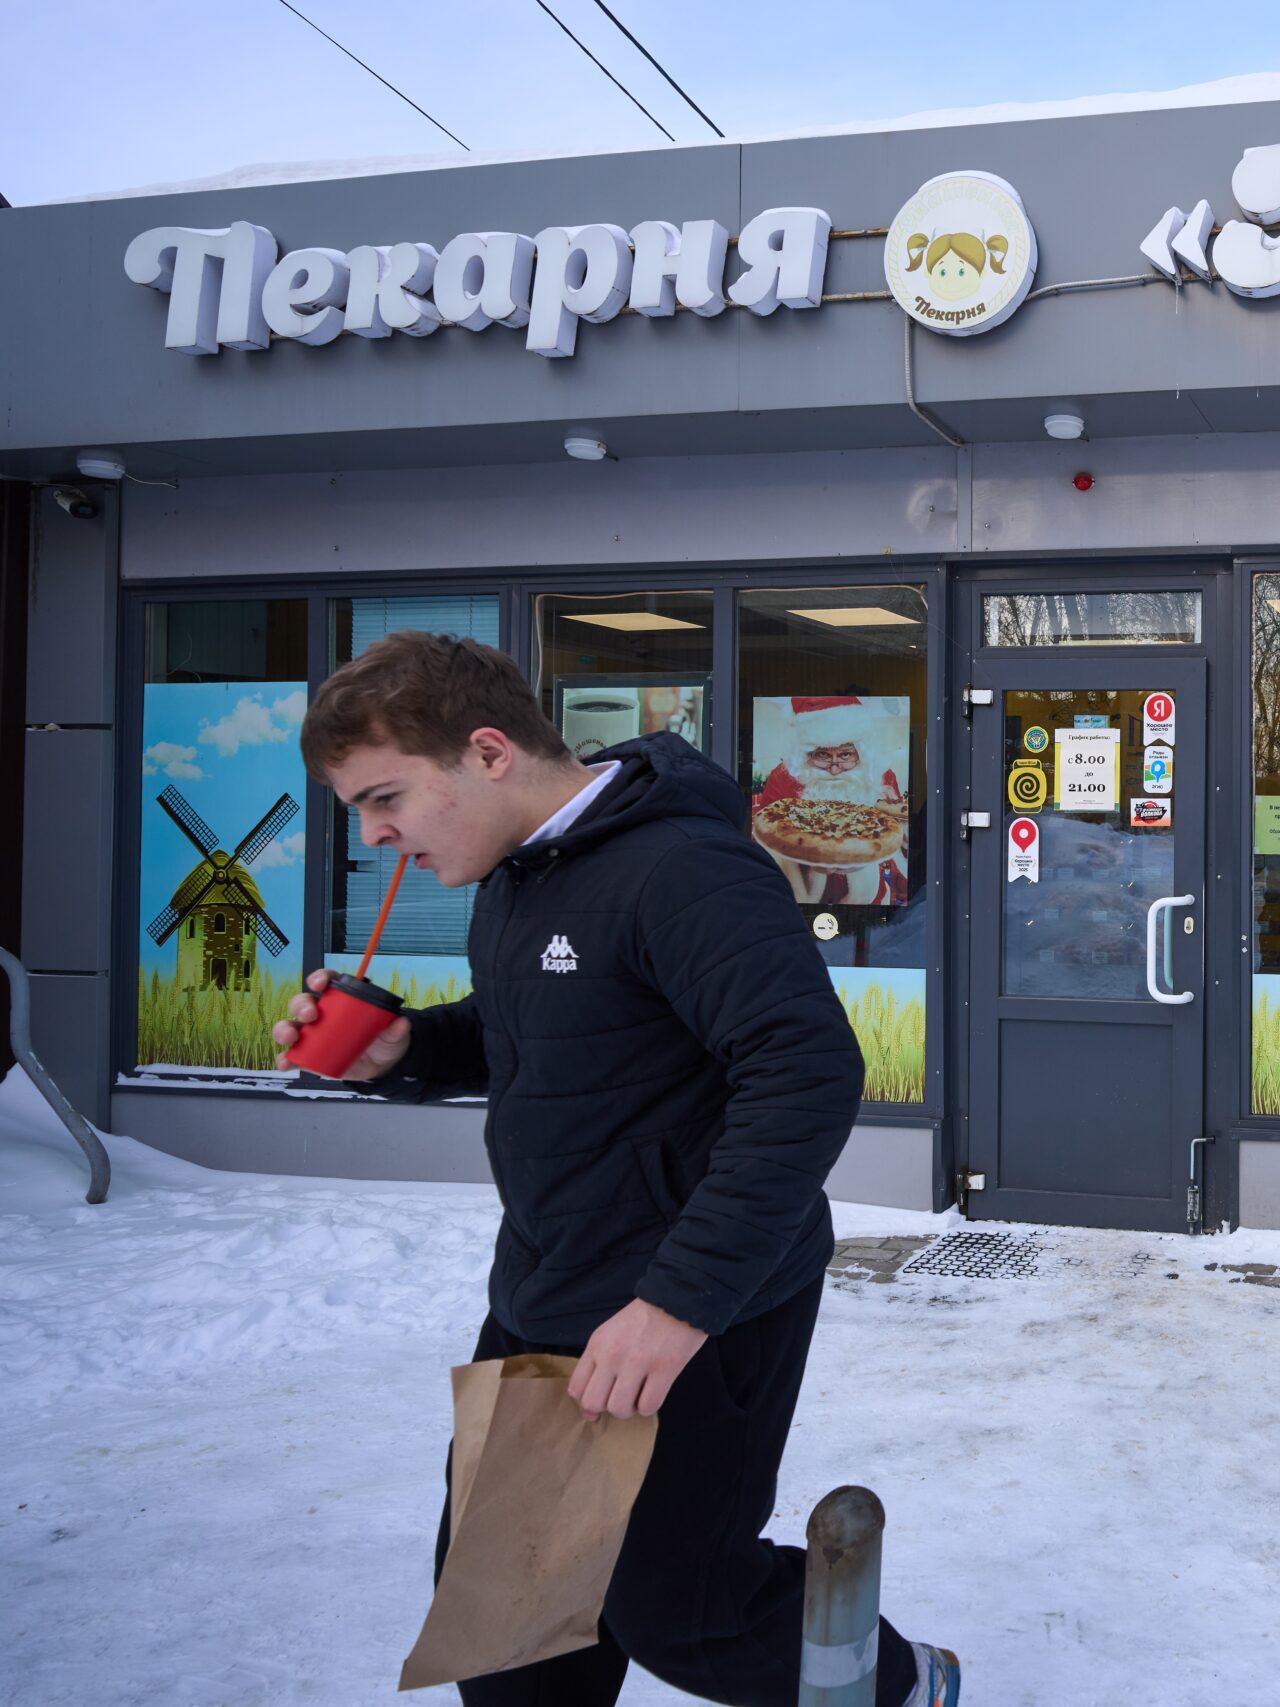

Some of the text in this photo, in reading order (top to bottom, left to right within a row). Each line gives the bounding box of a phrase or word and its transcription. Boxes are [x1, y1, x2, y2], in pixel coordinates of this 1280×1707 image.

[124, 207, 833, 357] Пекарня
[915, 296, 986, 324] Пекарня
[1075, 753, 1105, 764] 8.00
[1068, 784, 1106, 792] 21.00
[542, 957, 578, 973] Kappa
